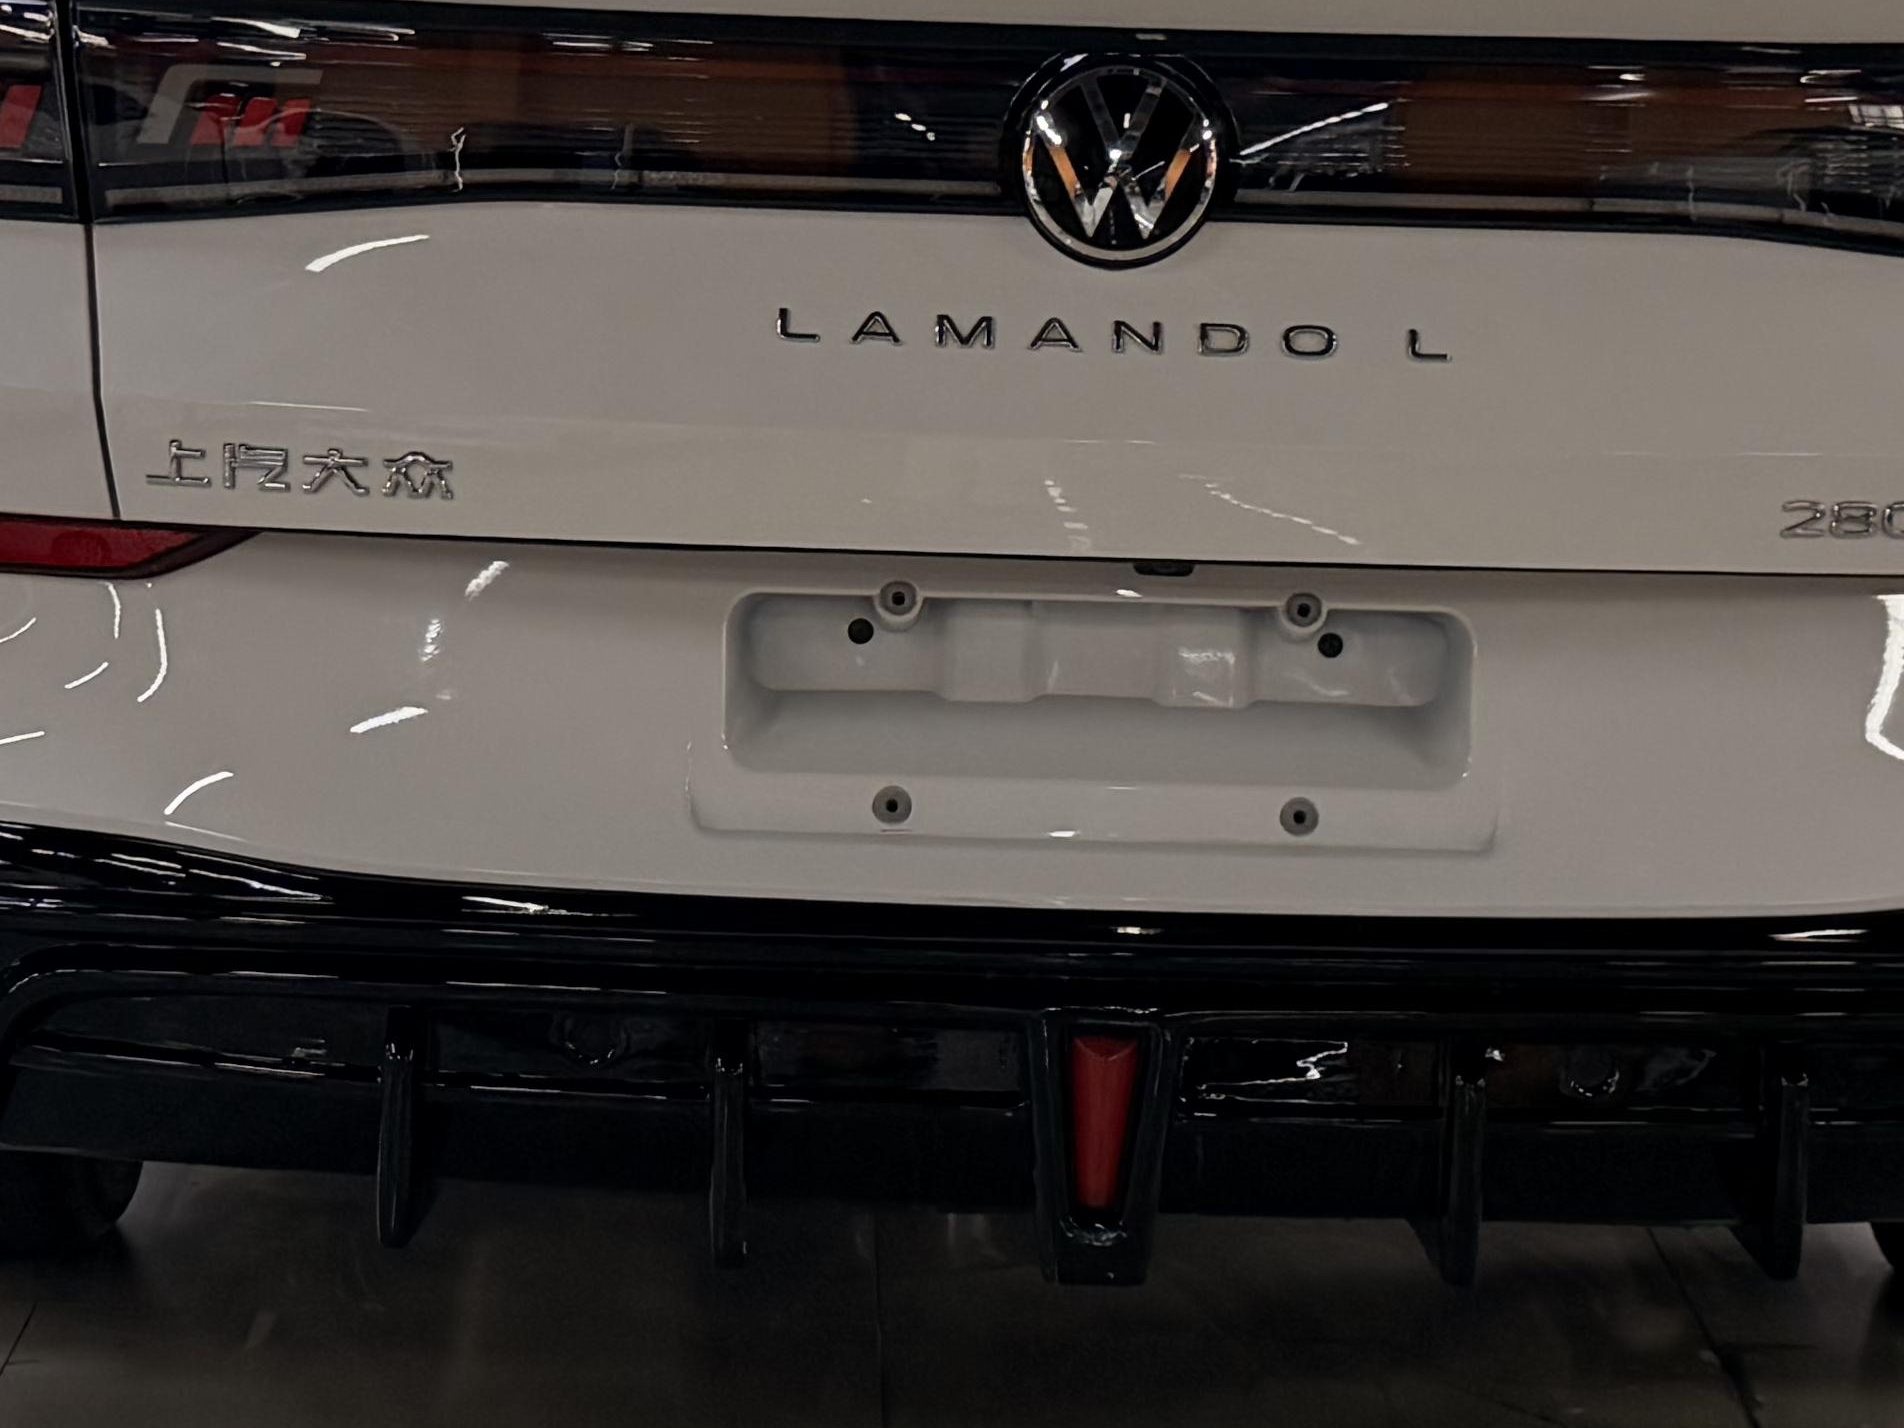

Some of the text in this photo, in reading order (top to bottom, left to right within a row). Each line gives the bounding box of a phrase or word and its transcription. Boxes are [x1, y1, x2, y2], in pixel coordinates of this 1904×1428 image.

[1028, 68, 1211, 248] VW
[774, 306, 1454, 363] LAMANDO L
[145, 438, 456, 502] 上汽大众
